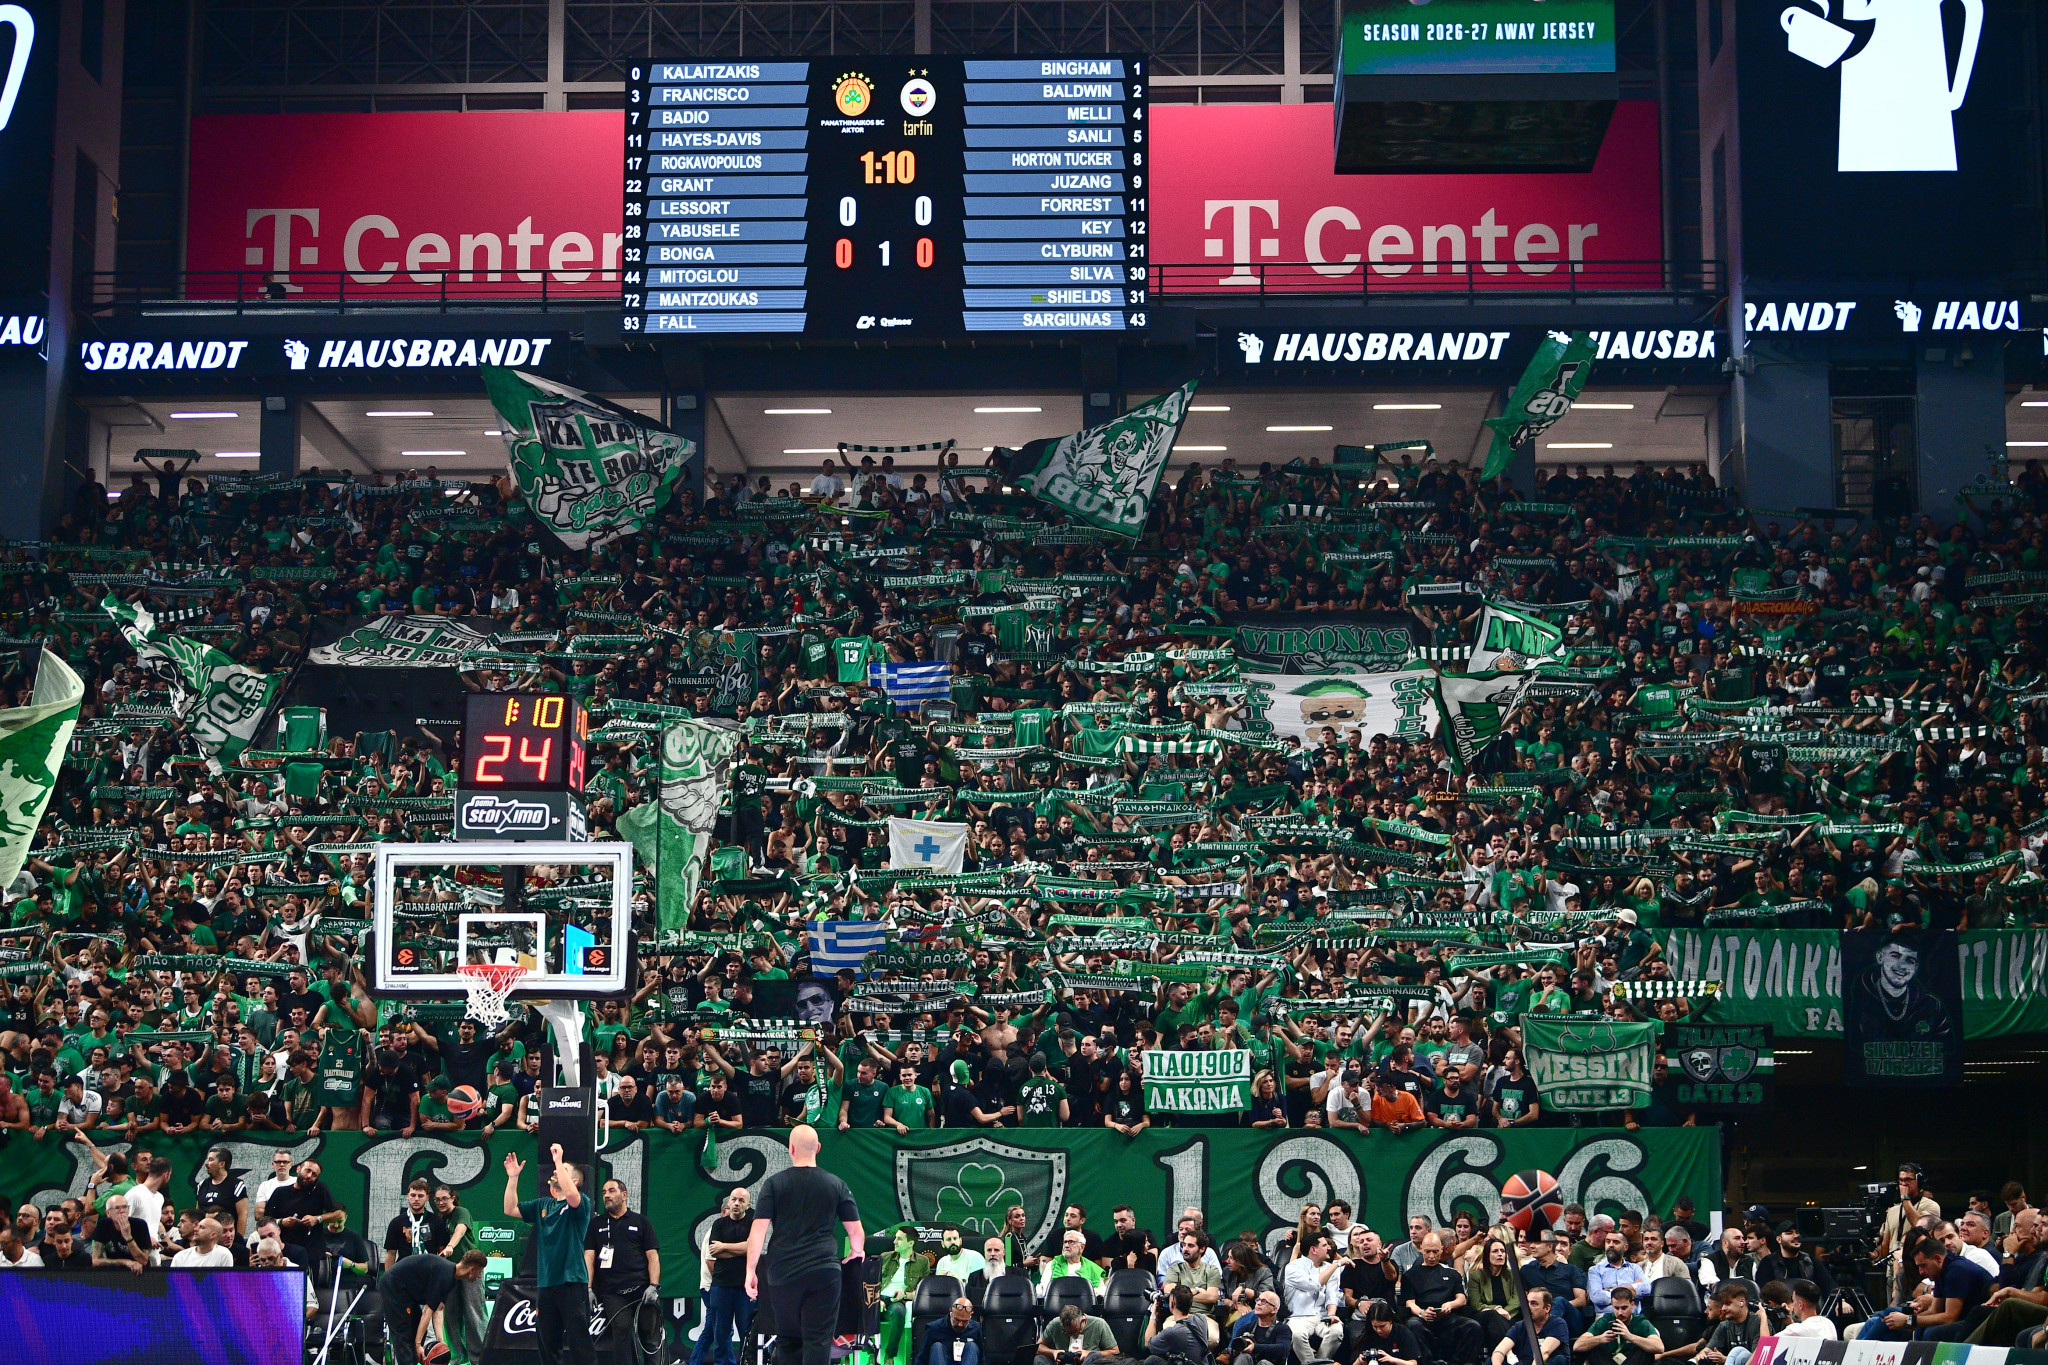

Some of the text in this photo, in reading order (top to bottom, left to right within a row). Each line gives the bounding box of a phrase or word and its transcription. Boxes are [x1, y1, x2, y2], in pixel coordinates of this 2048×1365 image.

[1364, 22, 1595, 41] SEASON 2026-27 AWAY JERSEY
[631, 64, 760, 81] 0 KALAITZAKIS
[1041, 61, 1141, 76] BINGHAM 1
[631, 87, 750, 103] 3 FRANCISCO
[1043, 84, 1142, 98] BALDWIN 2
[630, 110, 710, 125] 7 BADIO
[1067, 106, 1142, 121] MELLI 4
[821, 119, 885, 127] PANATHINAIKOS BC
[841, 126, 865, 134] AKTOR
[904, 119, 933, 136] tarfin
[627, 132, 762, 148] 11 HAYES-DAVIS
[1067, 129, 1142, 143] SANLI 5
[627, 155, 762, 170] 17 ROGKAVOPOULOS
[1012, 152, 1142, 167] HORTON TUCKER 8
[860, 150, 915, 185] 1:10
[626, 178, 714, 193] 22 GRANT
[1050, 174, 1142, 189] JUZANG 9
[625, 201, 731, 216] 26 LESSORT
[839, 196, 857, 227] 0
[915, 195, 932, 226] 0
[1041, 197, 1145, 212] FORREST 11
[625, 223, 740, 239] 28 YABUSELE
[1081, 220, 1146, 235] KEY 12
[1304, 206, 1600, 277] Center
[343, 215, 623, 285] Center
[624, 246, 715, 261] 32 BONGA
[835, 238, 853, 269] 0
[878, 240, 890, 266] 1
[916, 237, 934, 269] 0
[1041, 243, 1144, 258] CLYBURN 21
[624, 269, 739, 284] 44 MITOGLOU
[1069, 266, 1146, 281] SILVA 30
[624, 291, 759, 307] 72 MANTZOUKAS
[1047, 289, 1145, 304] SHIELDS 31
[623, 315, 697, 330] 93 FALL
[1022, 312, 1146, 327] SARGIUNAS 43
[318, 338, 552, 369] HAUSBRANDT
[1273, 332, 1511, 362] HAUSBRANDT
[627, 473, 651, 500] 13
[1505, 502, 1538, 512] GATE
[851, 547, 909, 559] LEVADIA
[884, 575, 922, 588] ΑΘΗΝΑ
[1023, 601, 1045, 611] GATE
[1047, 600, 1057, 610] 13
[574, 610, 633, 623] PANATHINAIKOS
[1240, 625, 1412, 656] VIRONAS
[843, 650, 859, 664] 13
[1191, 649, 1227, 661] ΘΥΡΑ 13
[1325, 650, 1389, 666] Never give
[1078, 659, 1096, 671] ΠΑΟ
[1123, 660, 1141, 672] ΠΑΟ
[1186, 683, 1209, 695] ULTRA
[242, 681, 267, 719] CLUB
[502, 695, 565, 728] 1:10
[475, 734, 553, 783] 24
[1117, 803, 1195, 813] ΠΑΝΑΘΗΝΑΪΚΟΣ
[1387, 822, 1440, 842] RAPID WIEN
[1196, 842, 1247, 852] PANATHINAIKOS
[962, 887, 1032, 898] ΠΑΝΑΘΗΝΑΪΚΟΣ
[185, 956, 213, 969] ΠΑΟ
[922, 952, 951, 966] ΠΑΟ
[856, 981, 954, 997] PANATHINAIKOS
[1353, 985, 1431, 998] ΠΑΝΑΘΗΝΑΪΚΟΣ
[850, 999, 902, 1014] ATHENS
[719, 1029, 784, 1041] PANATHINAIKOS
[1677, 1026, 1766, 1048] FILIATRA
[1527, 1043, 1653, 1086] MESSINI
[1045, 1084, 1055, 1096] 13
[1677, 1082, 1763, 1105] GATE 13
[548, 1099, 582, 1110] SPALDING
[1147, 1085, 1246, 1112] ΛΑΚΩΝΙΑ
[1552, 1088, 1631, 1110] GATE 13
